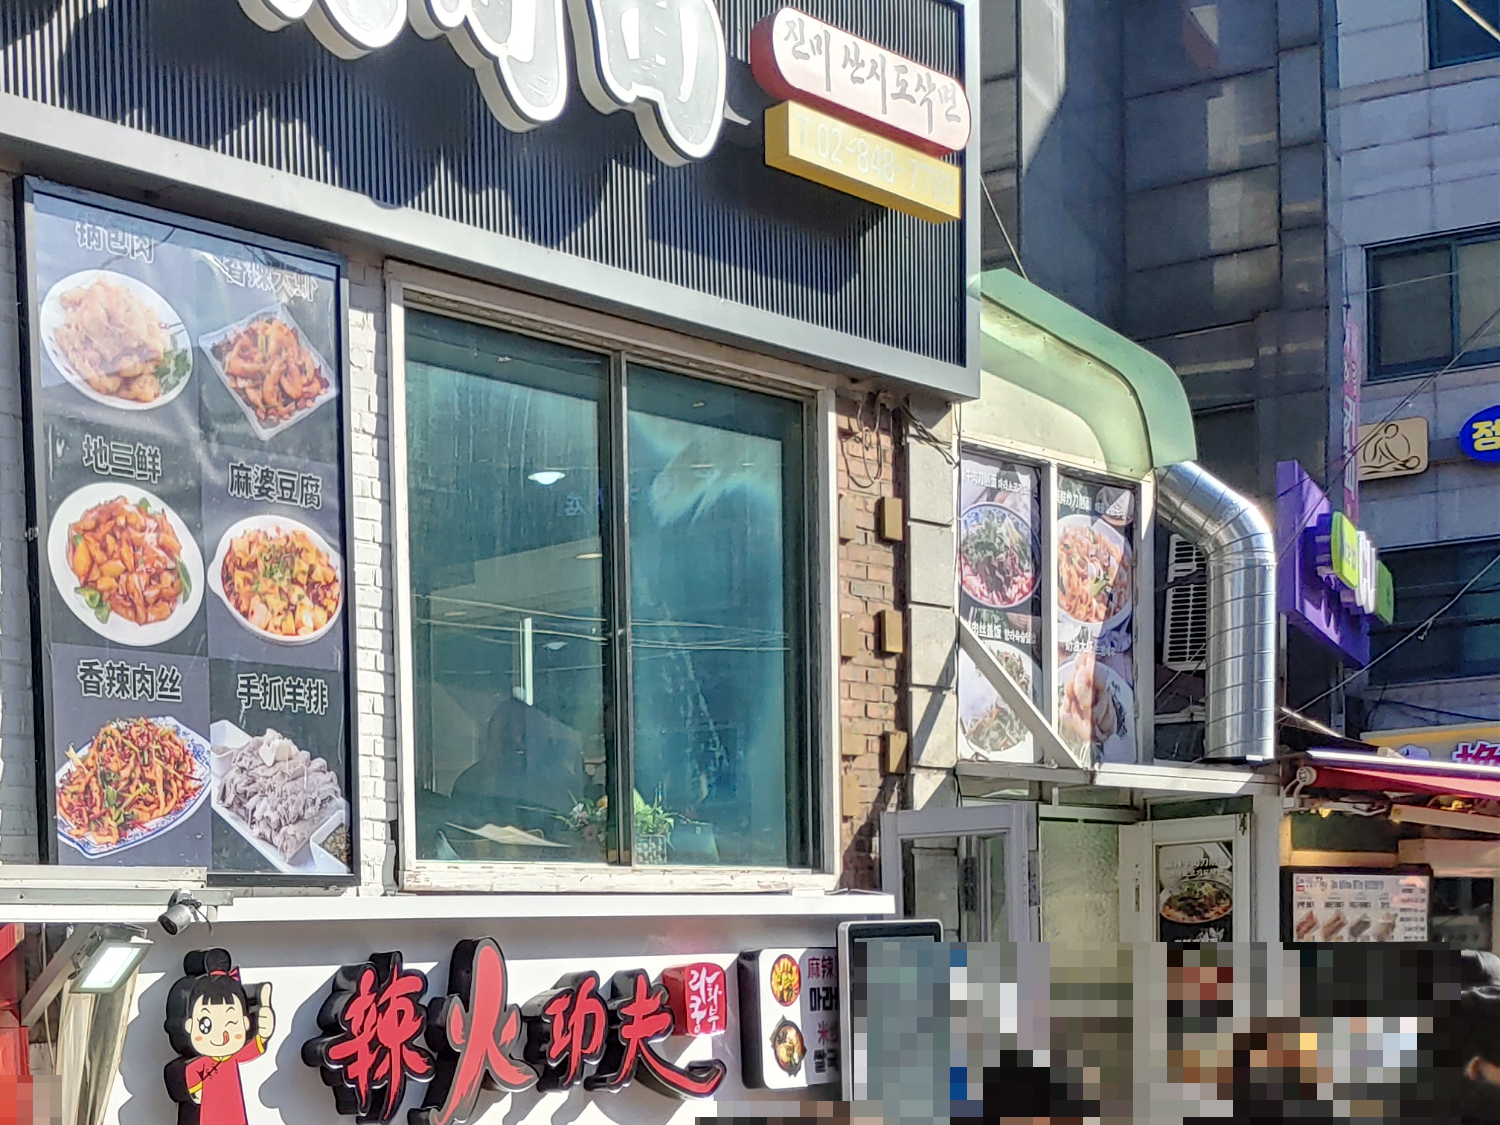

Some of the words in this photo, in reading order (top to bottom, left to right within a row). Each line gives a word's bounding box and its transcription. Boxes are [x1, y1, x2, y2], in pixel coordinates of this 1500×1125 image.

[784, 17, 831, 92] 진미
[842, 41, 962, 135] 산시도삭면
[83, 434, 162, 484] 地三鲜
[228, 462, 323, 510] 麻婆豆腐
[77, 659, 182, 702] 香辣肉丝
[237, 673, 329, 715] 手抓羊排
[807, 955, 837, 980] 麻辣
[809, 986, 838, 1012] 마라
